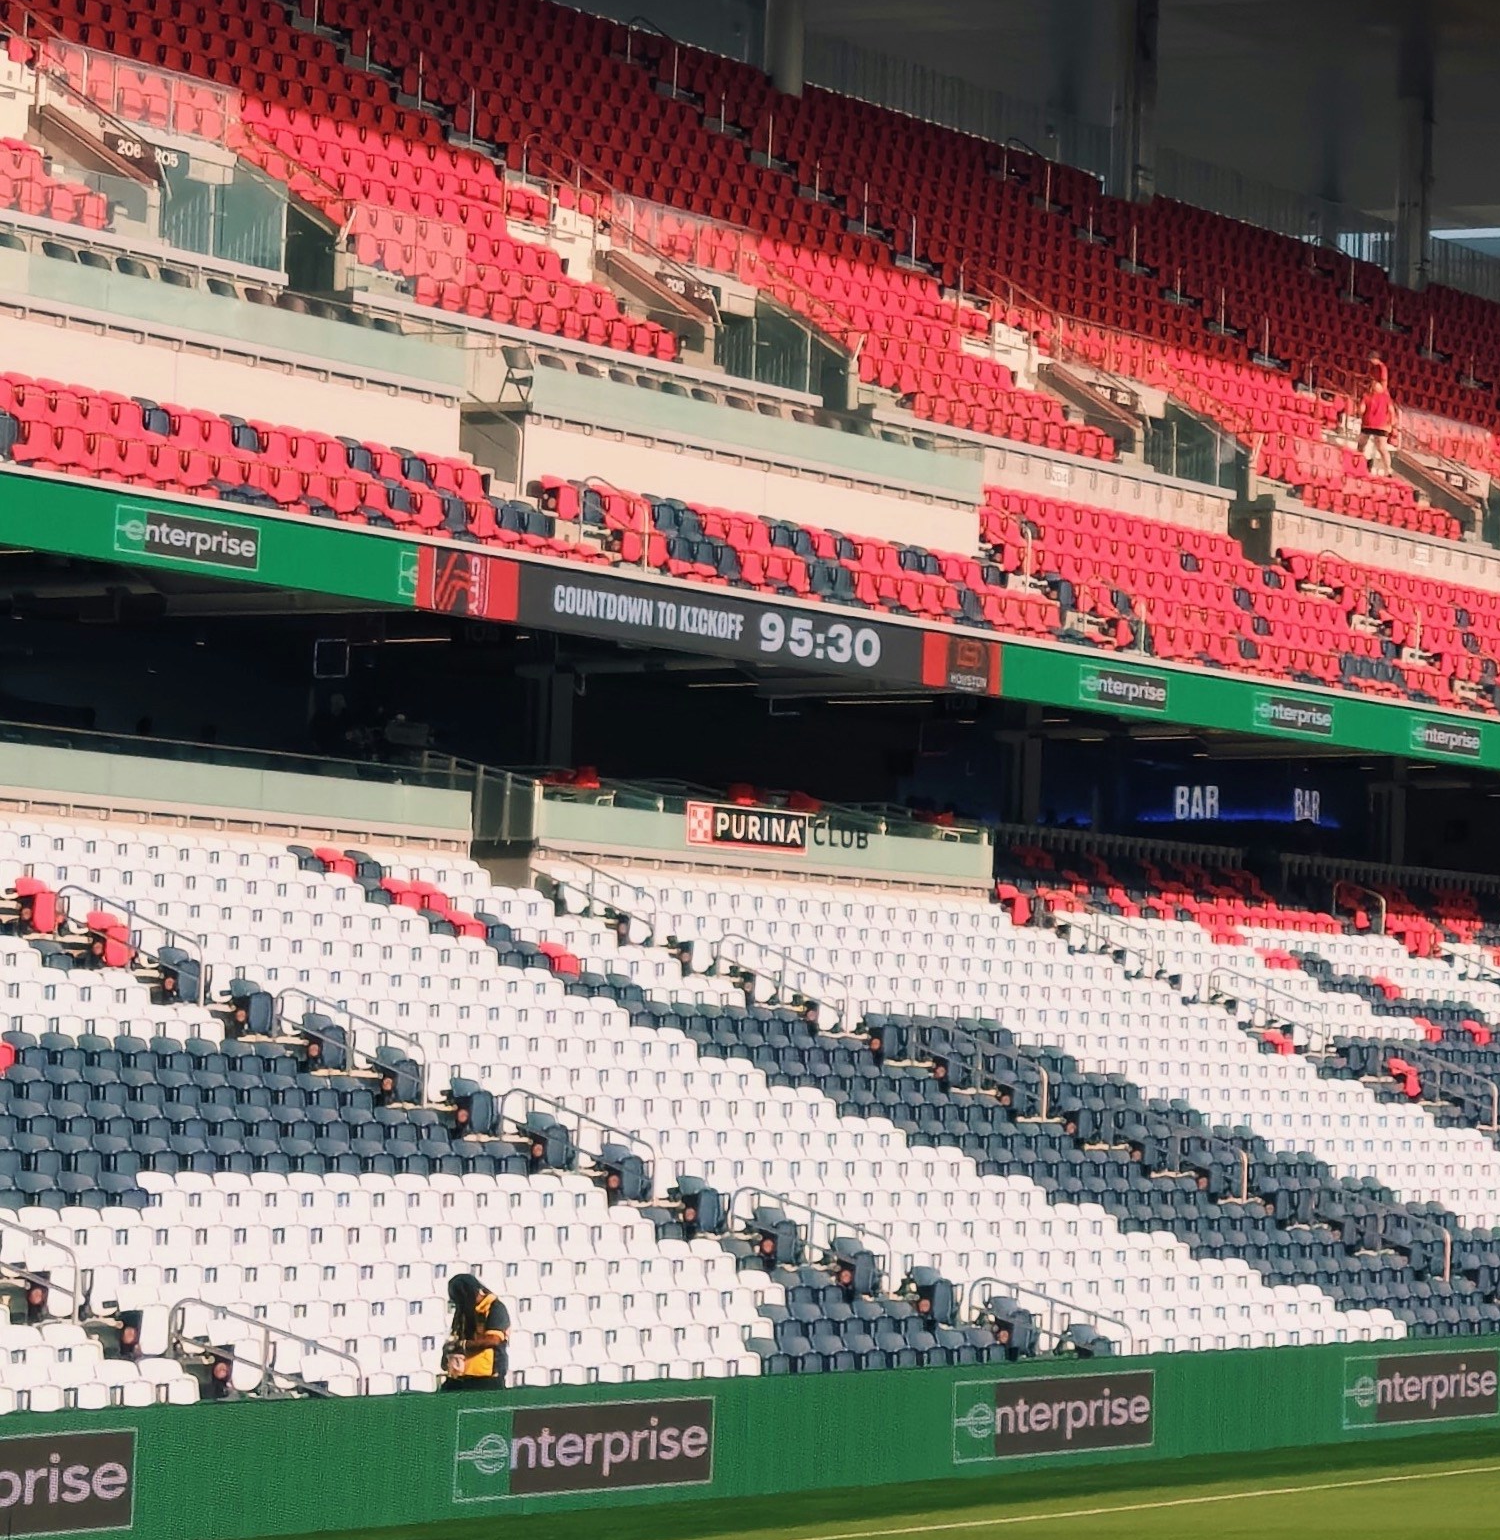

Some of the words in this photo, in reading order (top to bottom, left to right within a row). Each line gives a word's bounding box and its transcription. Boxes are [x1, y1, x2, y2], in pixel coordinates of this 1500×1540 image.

[116, 138, 142, 159] 206
[125, 520, 257, 558] enterprise
[553, 584, 654, 626] COUNTDOWN
[657, 600, 679, 631] TO
[679, 605, 745, 642] KICKOFF
[758, 611, 882, 669] 95:30
[1085, 675, 1167, 702] enterprise
[1259, 702, 1333, 727] enterprise
[1413, 727, 1480, 749] enterprise
[1175, 785, 1219, 820] BAR
[1294, 787, 1321, 824] BAR
[715, 811, 803, 845] PURINA
[813, 825, 869, 849] CLUB
[1354, 1362, 1498, 1410] enterprise
[966, 1387, 1151, 1439] enterprise
[471, 1415, 709, 1476] enterprise
